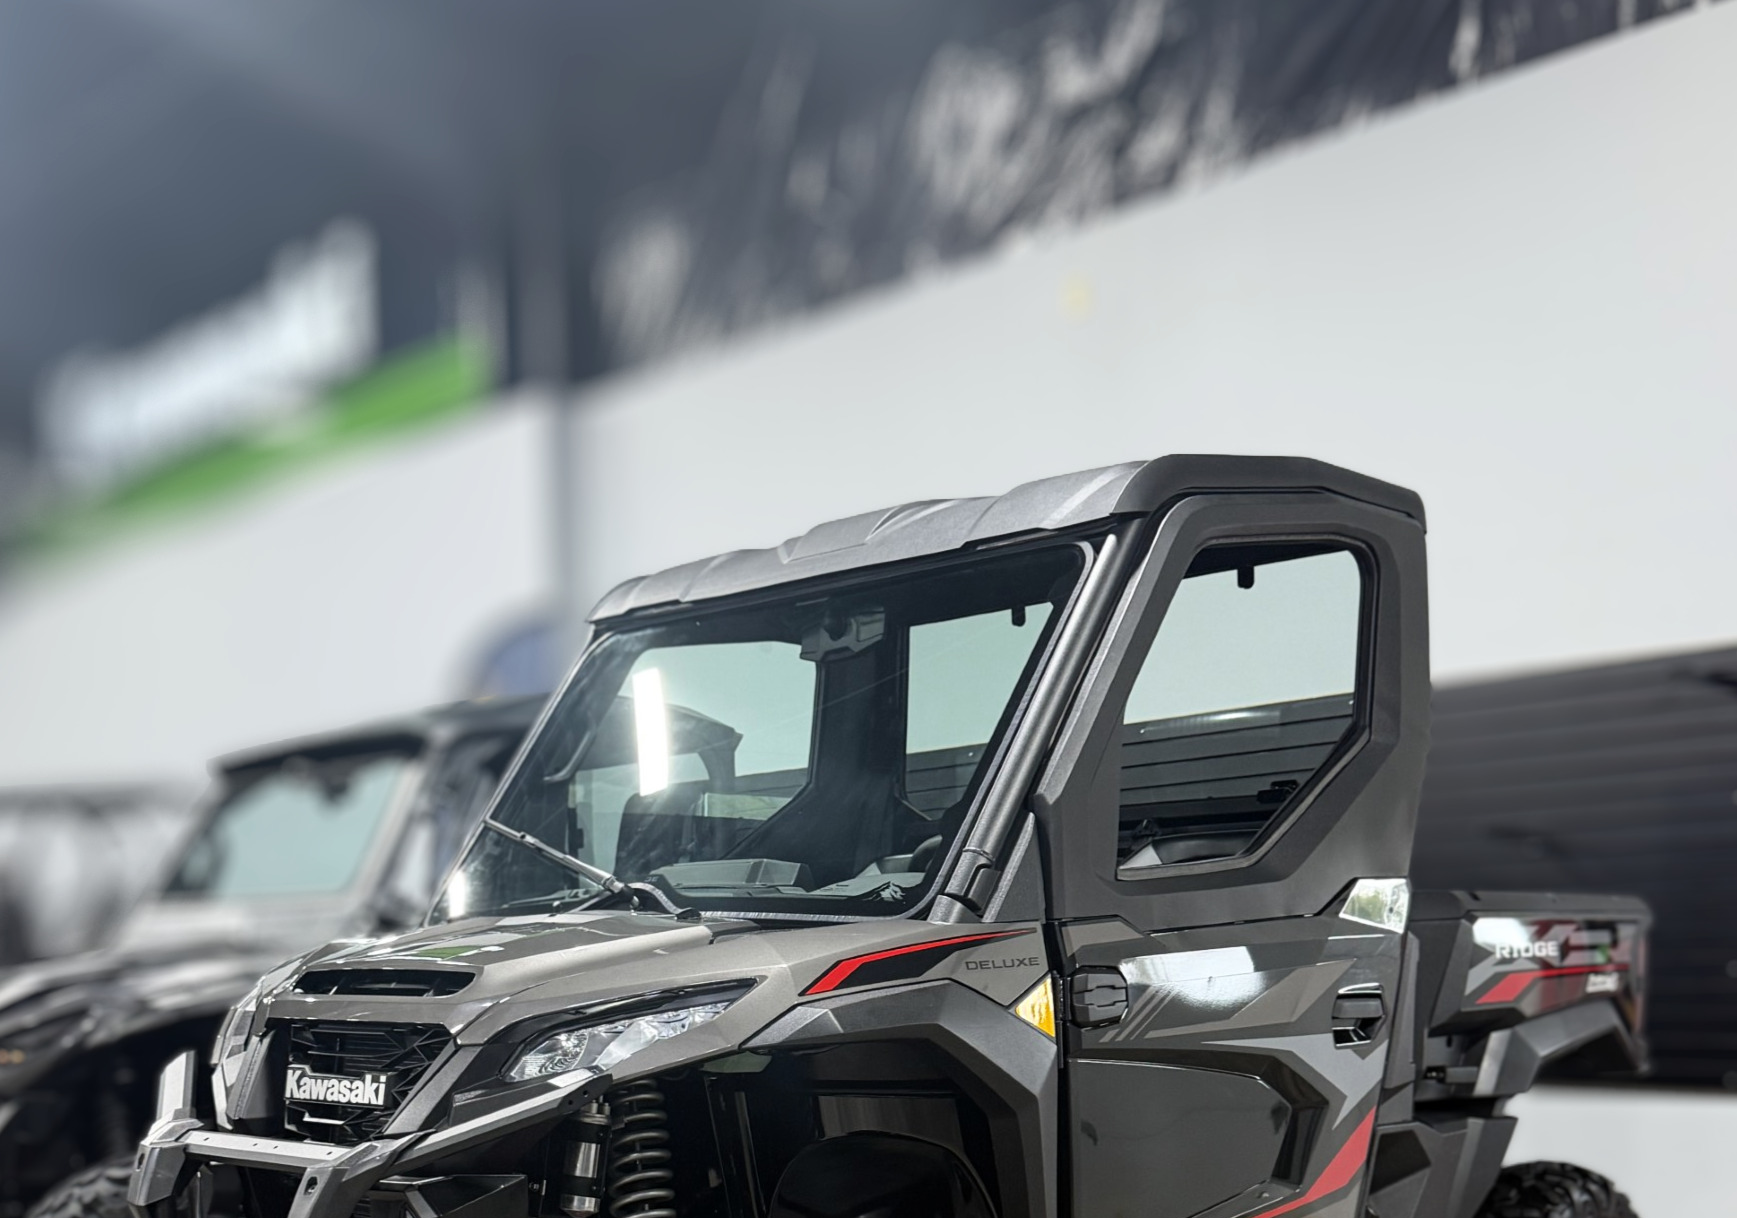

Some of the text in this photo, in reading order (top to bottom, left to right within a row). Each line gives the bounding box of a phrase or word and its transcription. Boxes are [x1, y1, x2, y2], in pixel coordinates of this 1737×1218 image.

[1495, 941, 1559, 959] RIDGE
[965, 957, 1040, 970] DELUXE
[285, 1070, 387, 1105] Kawasaki
